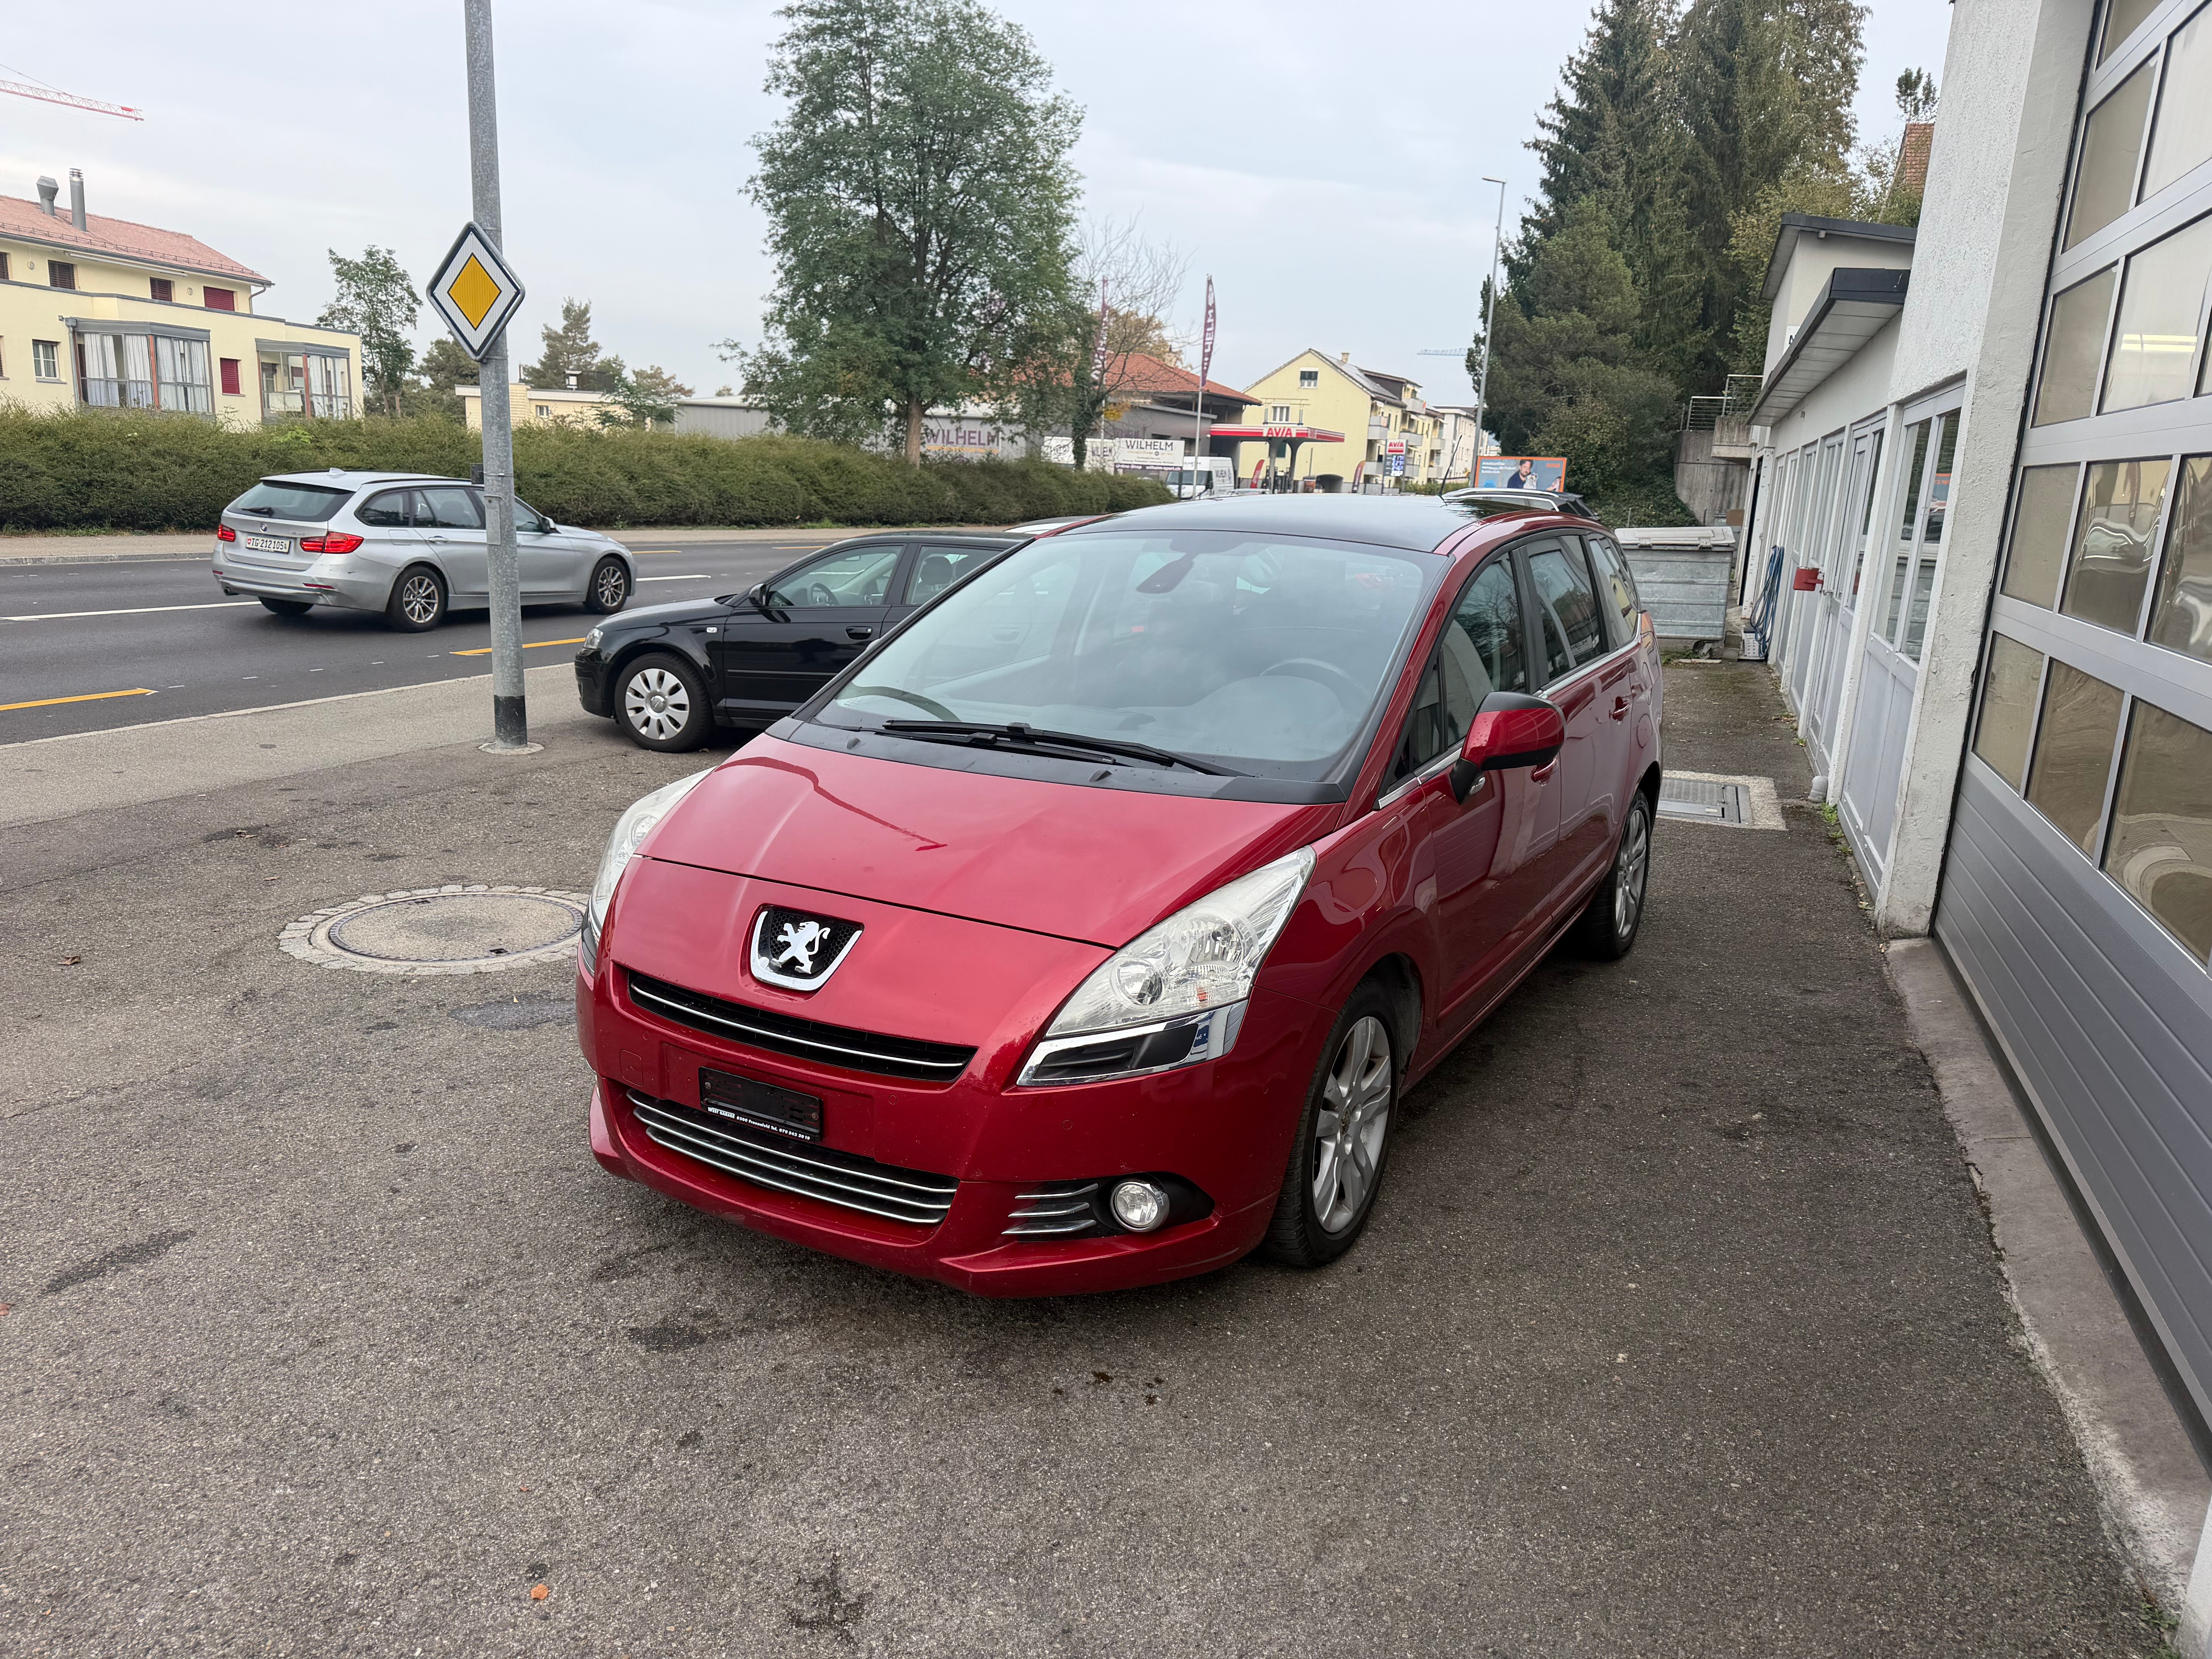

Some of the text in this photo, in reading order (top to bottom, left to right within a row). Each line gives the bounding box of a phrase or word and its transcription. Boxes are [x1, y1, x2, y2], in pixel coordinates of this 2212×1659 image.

[925, 429, 999, 446] WILHELM
[1267, 428, 1292, 437] AVIA
[1126, 440, 1173, 451] WILHELM
